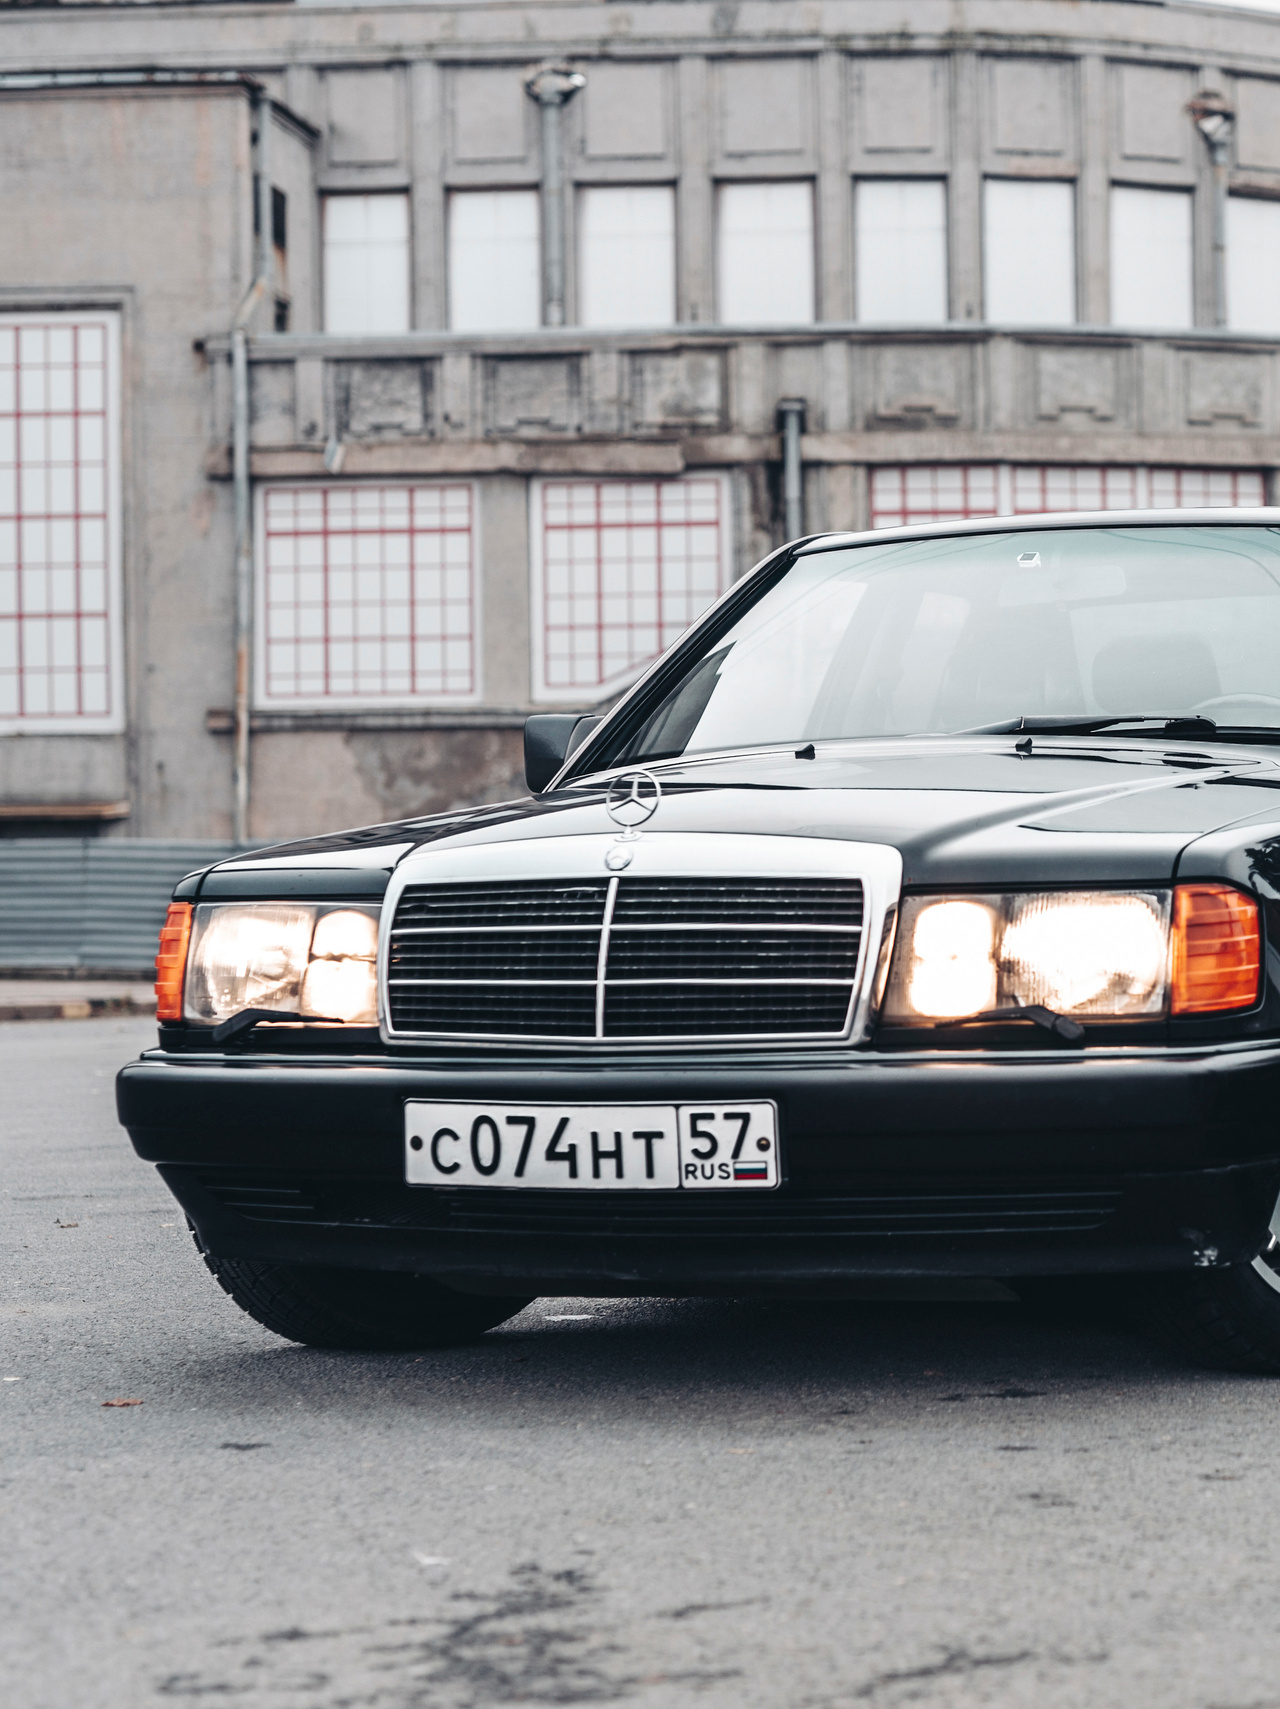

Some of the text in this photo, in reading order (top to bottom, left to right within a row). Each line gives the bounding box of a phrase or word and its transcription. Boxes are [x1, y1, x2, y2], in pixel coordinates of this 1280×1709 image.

[431, 1112, 752, 1180] C074HT 57
[684, 1162, 731, 1180] RUS
